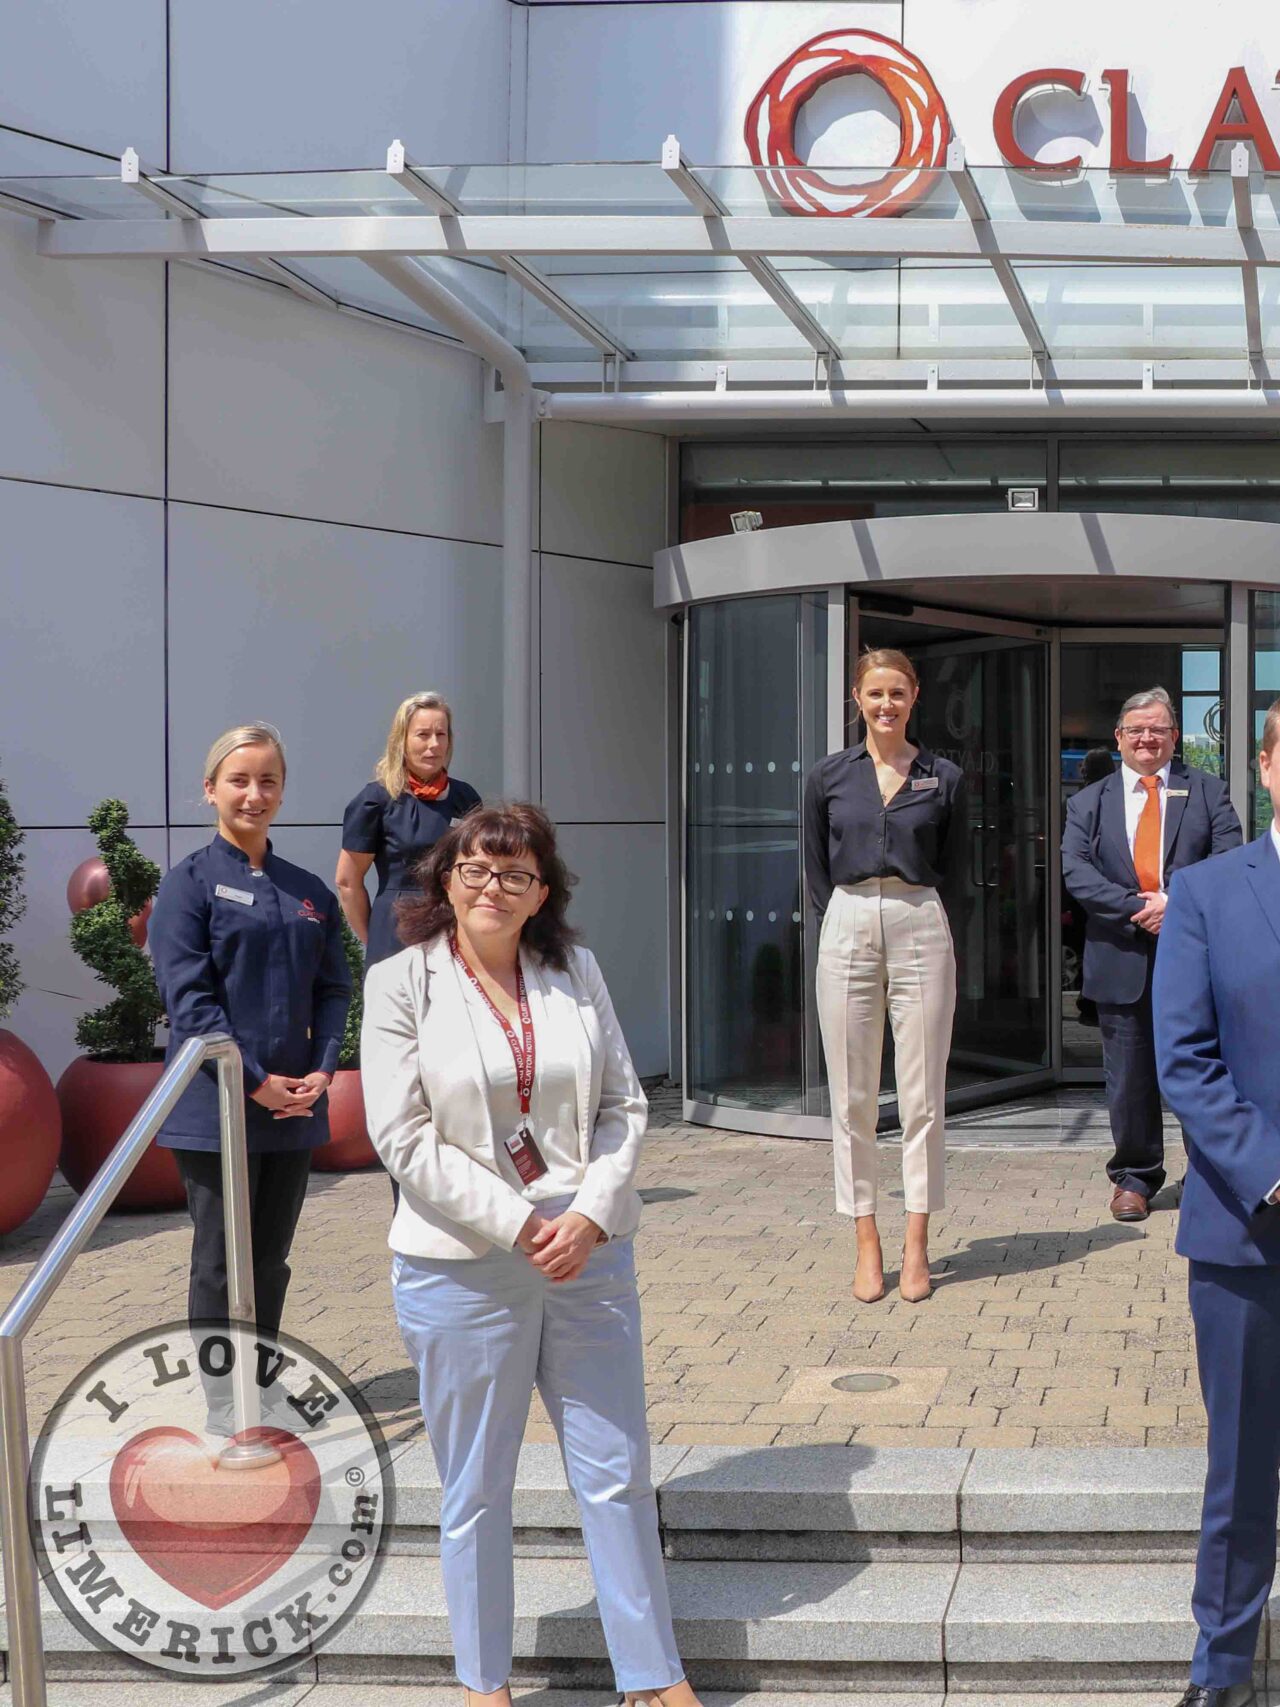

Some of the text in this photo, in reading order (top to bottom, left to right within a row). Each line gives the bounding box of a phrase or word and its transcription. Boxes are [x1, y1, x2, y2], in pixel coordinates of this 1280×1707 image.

[510, 1038, 524, 1069] CLAYTON
[525, 1031, 533, 1086] CLAYTON HOTELS
